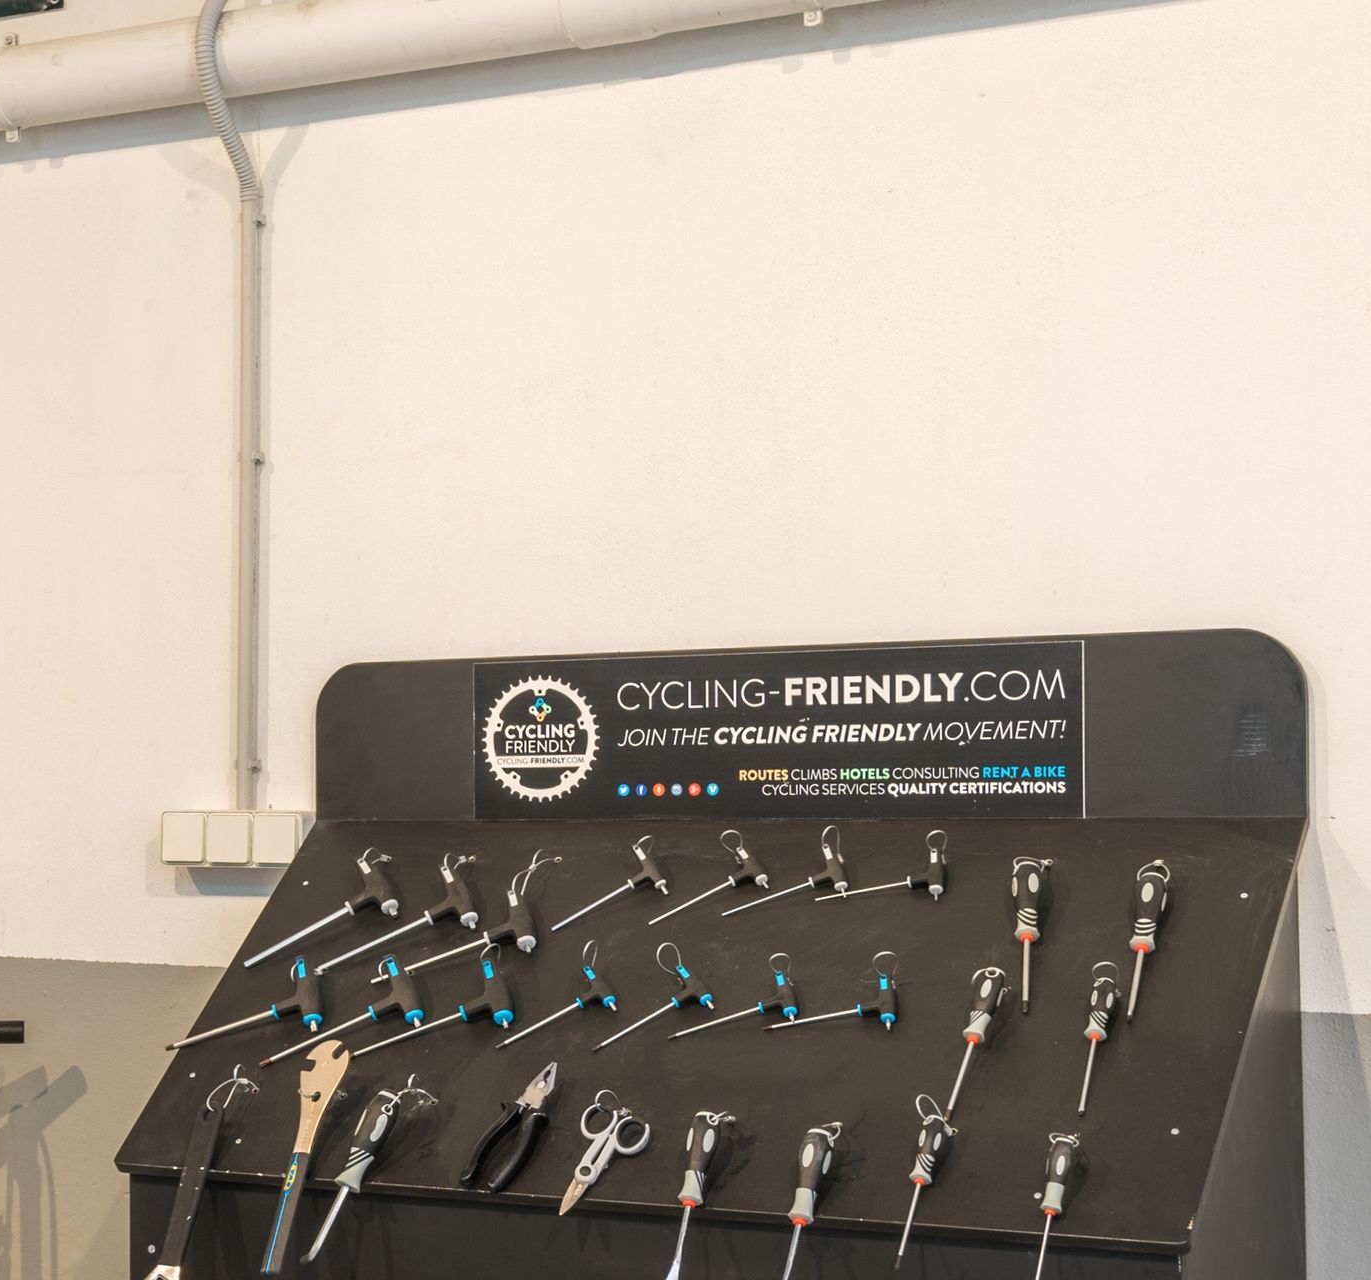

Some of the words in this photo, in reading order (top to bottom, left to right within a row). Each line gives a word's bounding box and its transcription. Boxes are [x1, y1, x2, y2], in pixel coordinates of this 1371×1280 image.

[616, 669, 1066, 711] CYCLING-FRIENDLY.COM
[505, 723, 575, 739] CYCLING
[617, 728, 667, 748] JOIN
[671, 727, 711, 746] THE
[714, 725, 807, 745] CYCLING
[811, 722, 922, 744] FRIENDLY
[923, 720, 1066, 741] MOVEMENT!
[505, 739, 576, 754] FRIENDLY
[497, 756, 585, 765] CYCLING-FRIENDLY.COM
[739, 769, 788, 782] ROUTES
[791, 768, 837, 781] CLIMBS
[840, 768, 890, 780] HOTELS
[892, 767, 980, 780] CONSULTING
[983, 766, 1019, 779] RENT
[1021, 766, 1031, 778] A
[1034, 766, 1066, 778] BIKE
[762, 783, 819, 797] CYCLING
[822, 783, 885, 796] SERVICES
[887, 782, 947, 795] QUALITY
[949, 781, 1066, 794] CERTIFICATIONS
